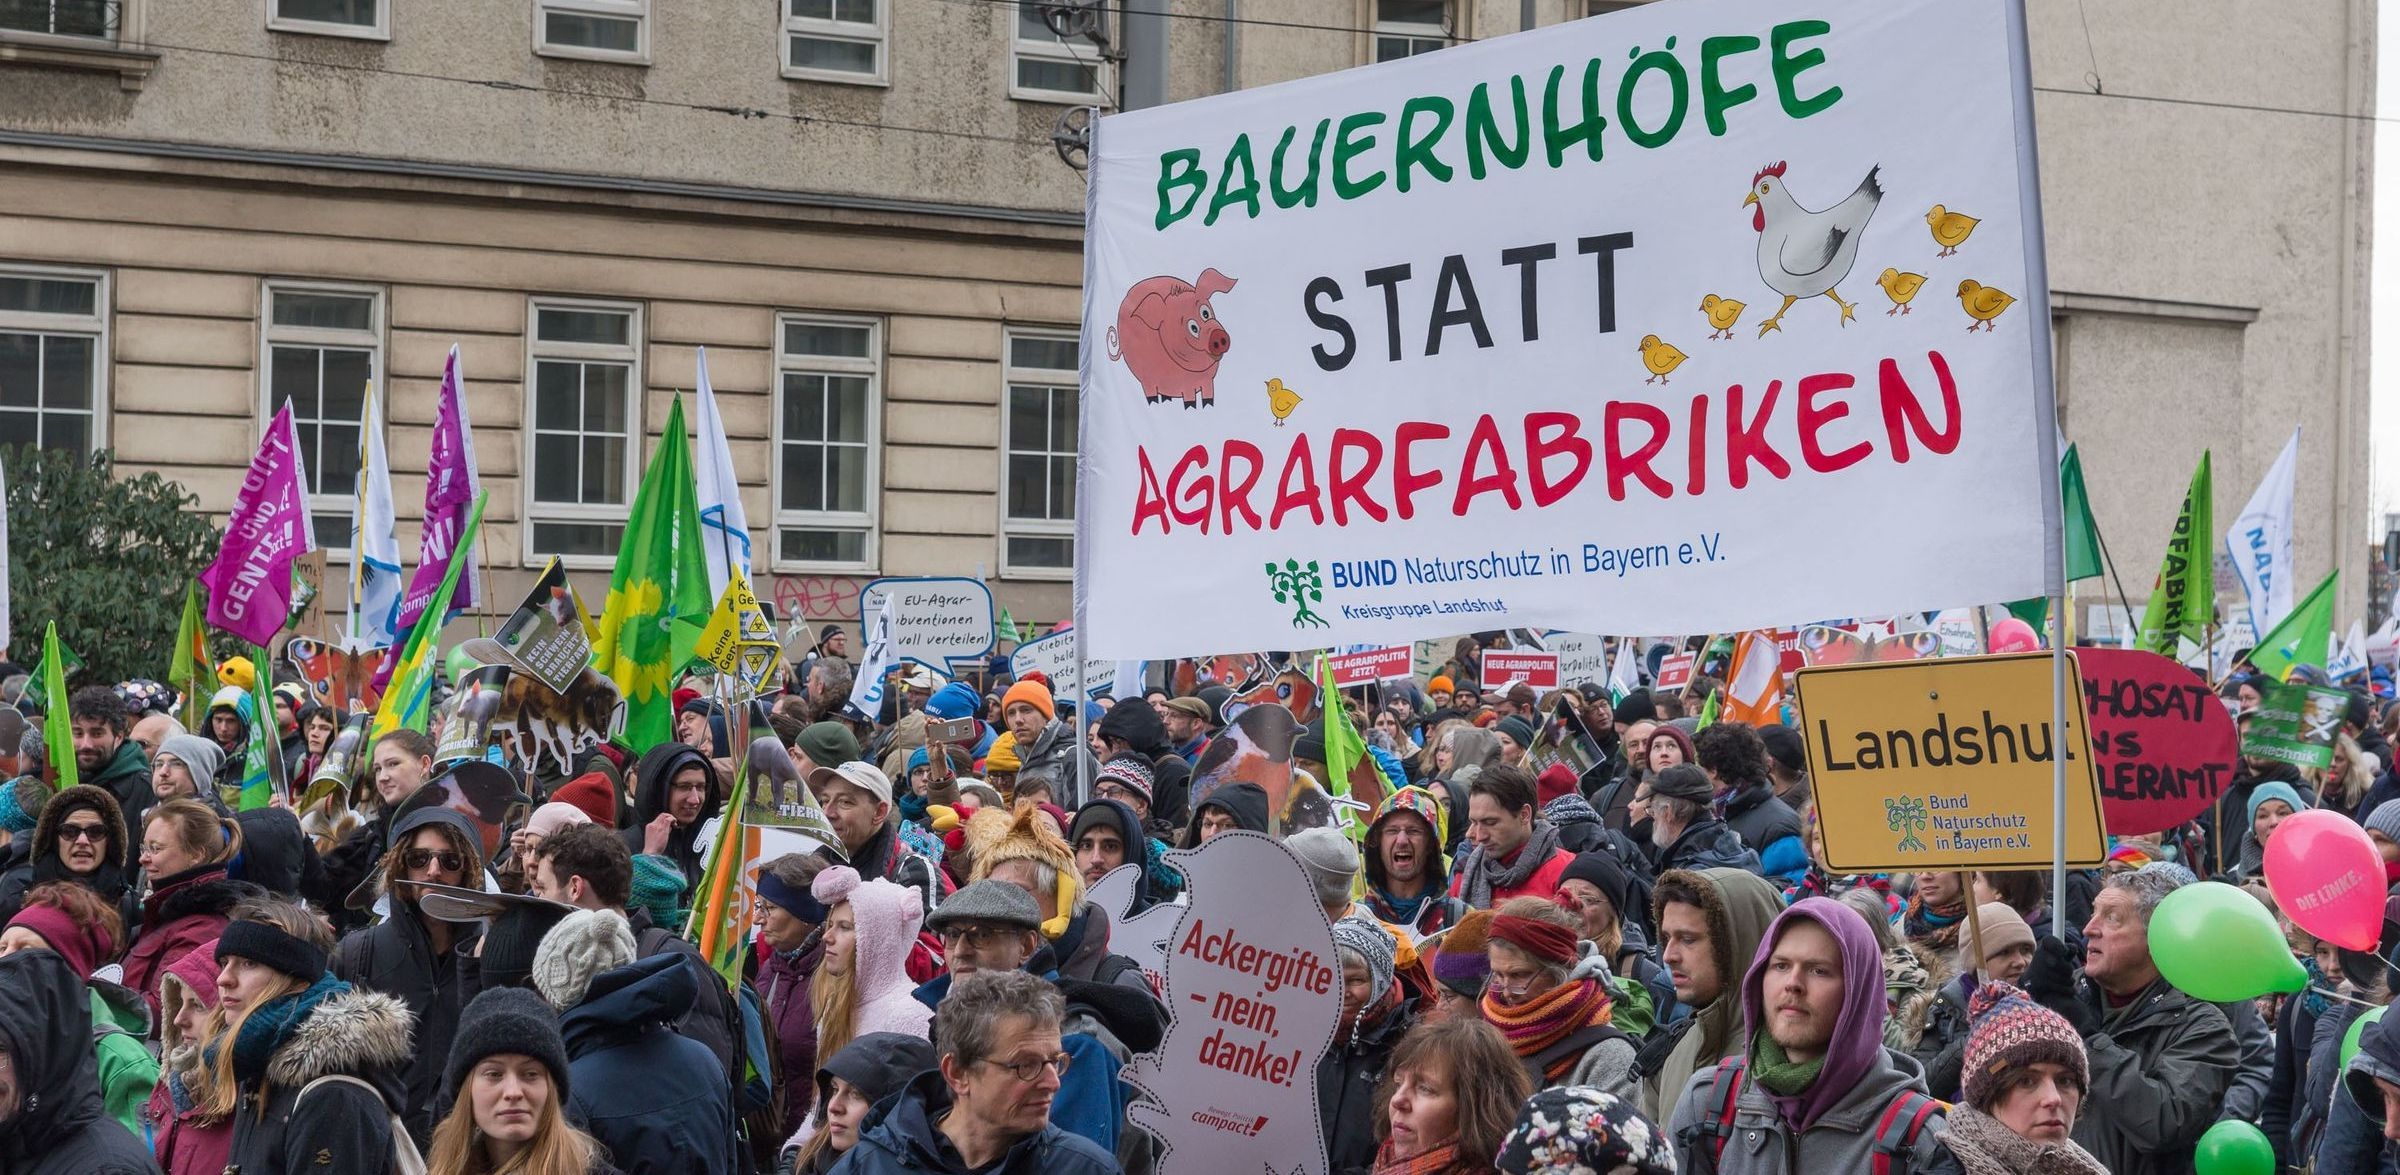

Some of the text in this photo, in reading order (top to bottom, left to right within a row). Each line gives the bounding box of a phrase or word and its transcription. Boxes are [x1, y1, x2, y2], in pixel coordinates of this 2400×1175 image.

[1155, 20, 1844, 231] BAUERNHÖFE
[1304, 231, 1634, 372] STATT
[1130, 350, 1962, 538] AGRARFABRIKEN
[242, 431, 289, 494] GIFT
[239, 500, 277, 540] UND
[1332, 532, 1726, 588] BUND Naturschutz in Bayern e.V.
[2159, 487, 2192, 661] ERFABRIK
[738, 593, 758, 606] Ge
[904, 593, 973, 608] EU-Agrar-
[1341, 597, 1508, 621] Kreisgruppe Landshut
[526, 638, 548, 663] KEIN
[535, 628, 571, 670] SCHWEIN
[544, 632, 580, 677] BRAUCHT
[708, 628, 732, 665] Keine
[898, 632, 989, 646] voll verteilen!
[1560, 642, 1582, 652] Neue
[1344, 650, 1407, 669] AGRARPOLITIK
[1487, 659, 1555, 670] NEUE AGRARPOLITIK
[1561, 656, 1600, 672] rarpolitik
[2091, 730, 2142, 757] NS
[2096, 762, 2229, 800] LERAMT
[1929, 794, 1969, 809] Bund
[1933, 813, 2027, 830] Naturschutz
[1936, 833, 2031, 852] in Bayern e.V.
[2317, 869, 2363, 905] LINKE.
[1178, 919, 1333, 995] Ackergifte
[1212, 991, 1279, 1038] nein,
[1198, 1028, 1301, 1088] danke!
[1191, 1111, 1269, 1138] campact!
